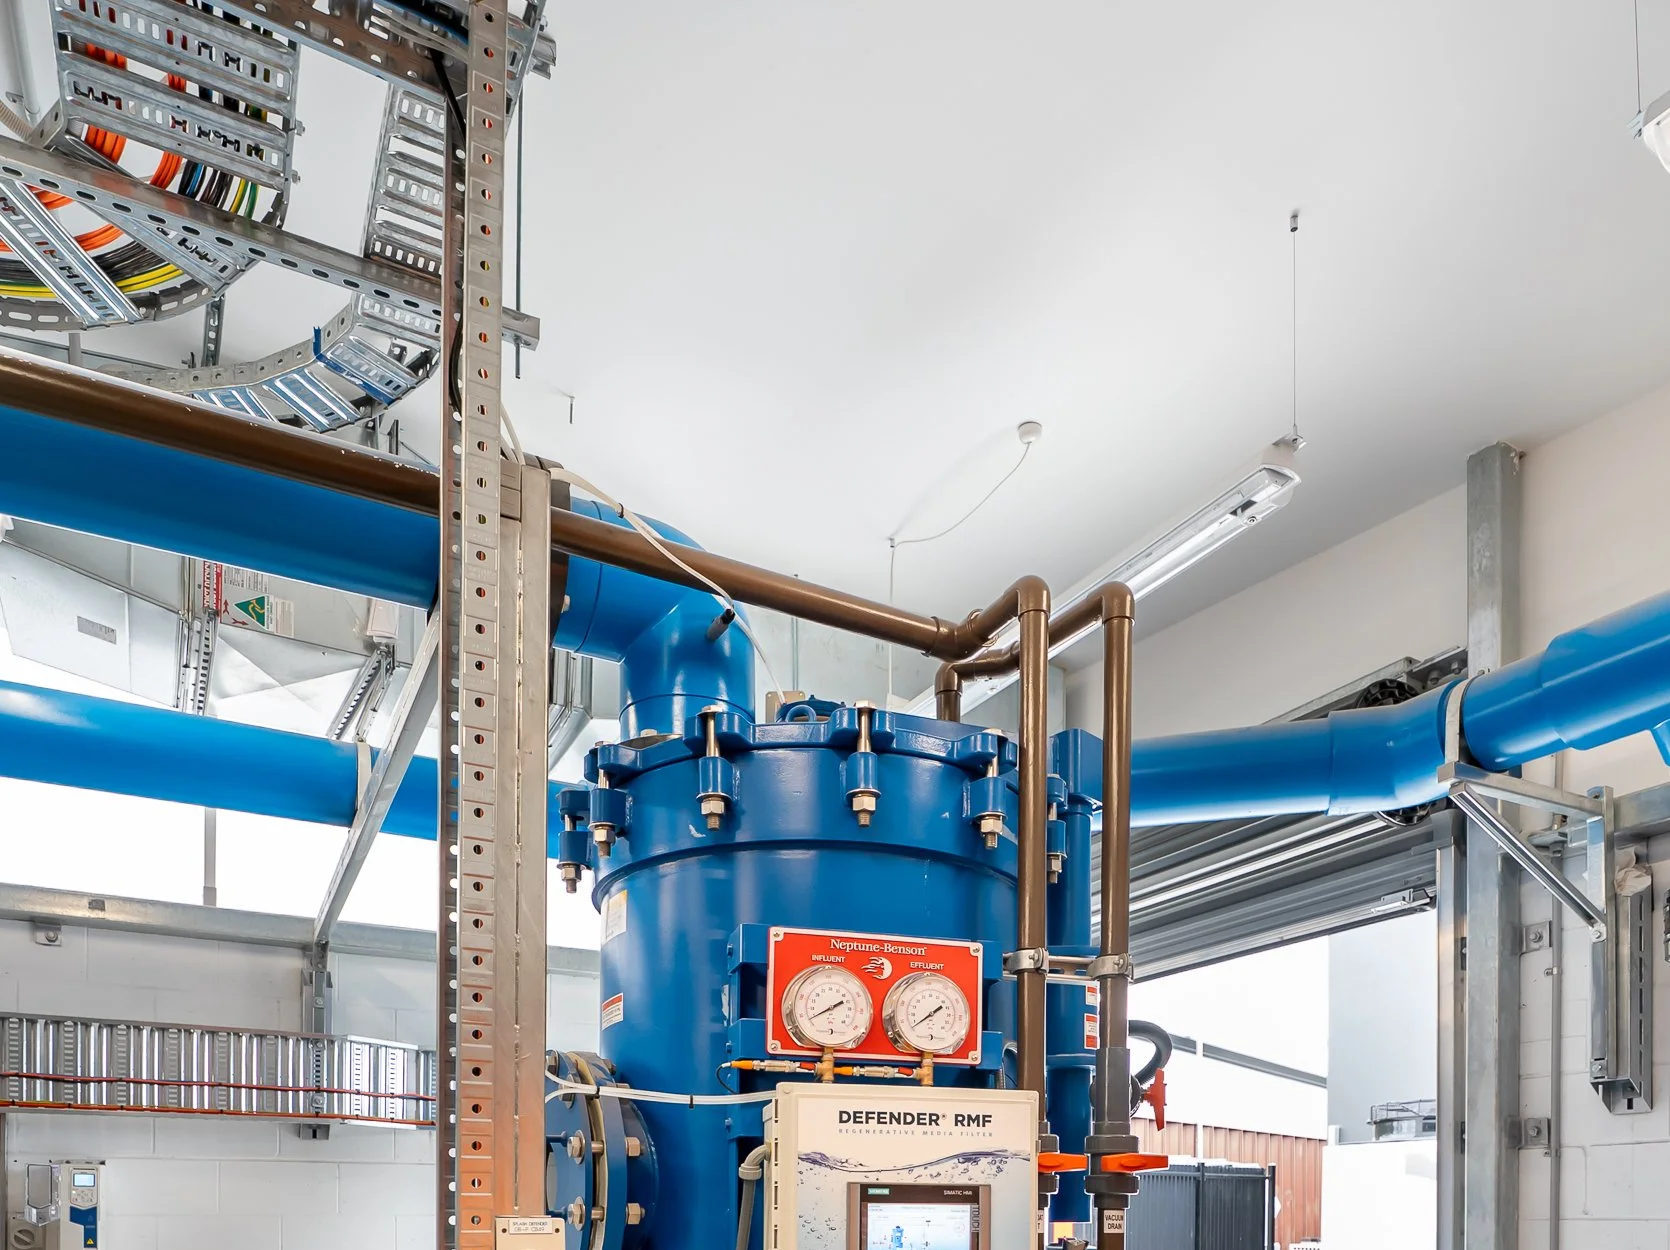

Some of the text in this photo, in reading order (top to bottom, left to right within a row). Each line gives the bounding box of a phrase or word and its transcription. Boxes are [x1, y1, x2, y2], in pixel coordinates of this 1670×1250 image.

[830, 939, 926, 956] Neptune-Benson
[811, 954, 846, 963] INFLUENT
[910, 961, 945, 970] EFFLUENT
[954, 1113, 993, 1128] RMF
[838, 1128, 915, 1136] REGENERATIVE
[972, 1206, 980, 1232] TOUCH
